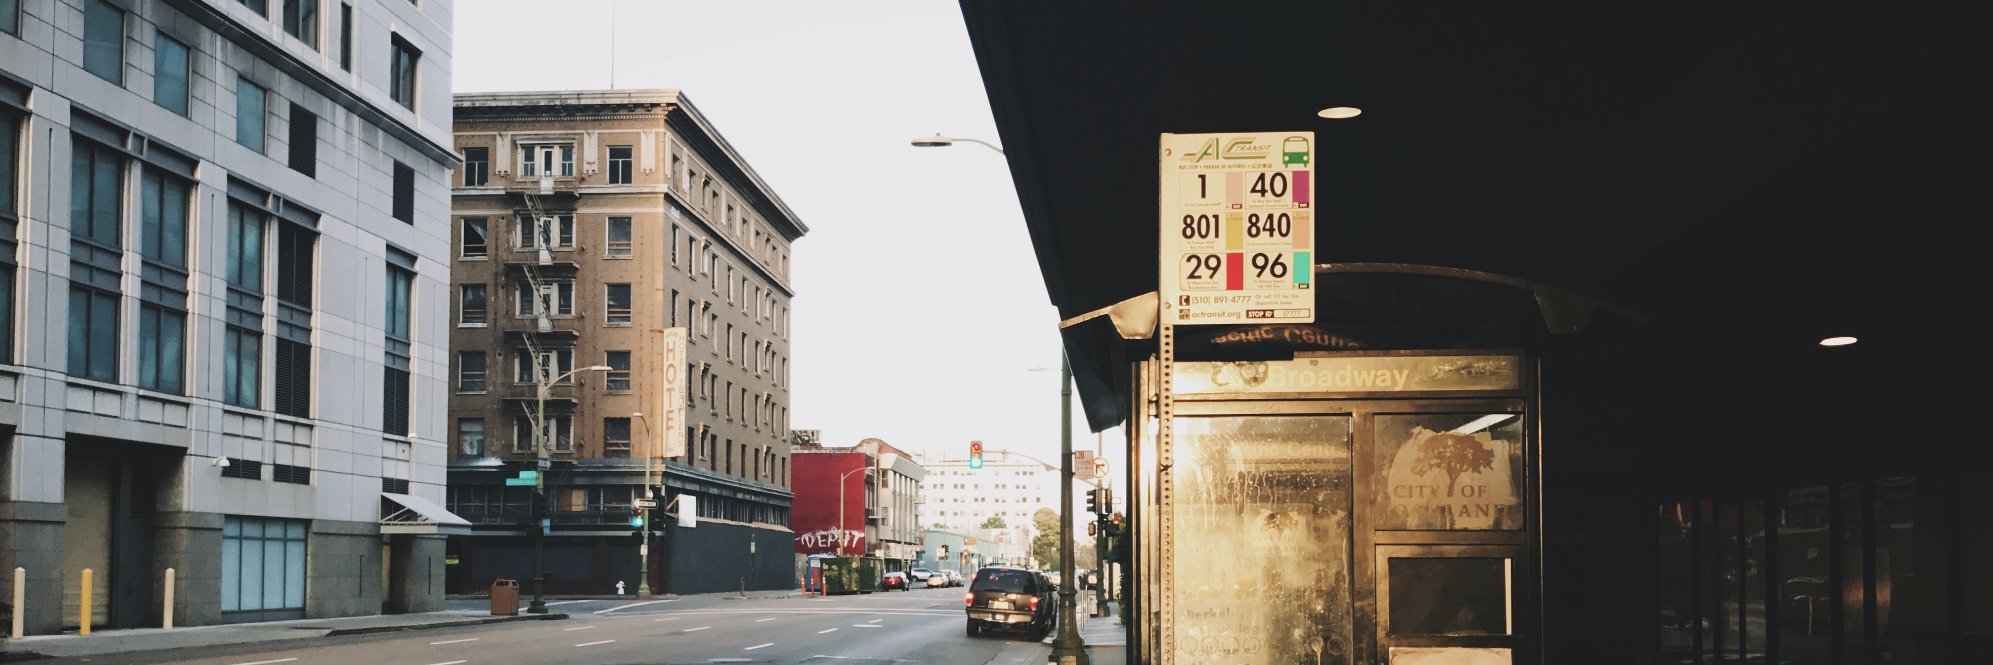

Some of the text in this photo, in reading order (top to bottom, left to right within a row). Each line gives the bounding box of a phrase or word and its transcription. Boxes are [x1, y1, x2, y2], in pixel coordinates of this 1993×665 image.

[1235, 144, 1272, 152] TRANSIT
[1198, 174, 1207, 199] 1
[1250, 172, 1288, 198] 40
[1182, 214, 1220, 240] 801
[1247, 212, 1291, 238] 840
[1185, 254, 1222, 280] 29
[1251, 252, 1288, 278] 96
[1192, 295, 1211, 305] (510)
[1191, 311, 1241, 320] actransit.org
[1248, 310, 1264, 318] STOP
[1267, 365, 1409, 391] Broadway
[666, 340, 677, 452] HOTE
[1394, 484, 1487, 498] CITY OF
